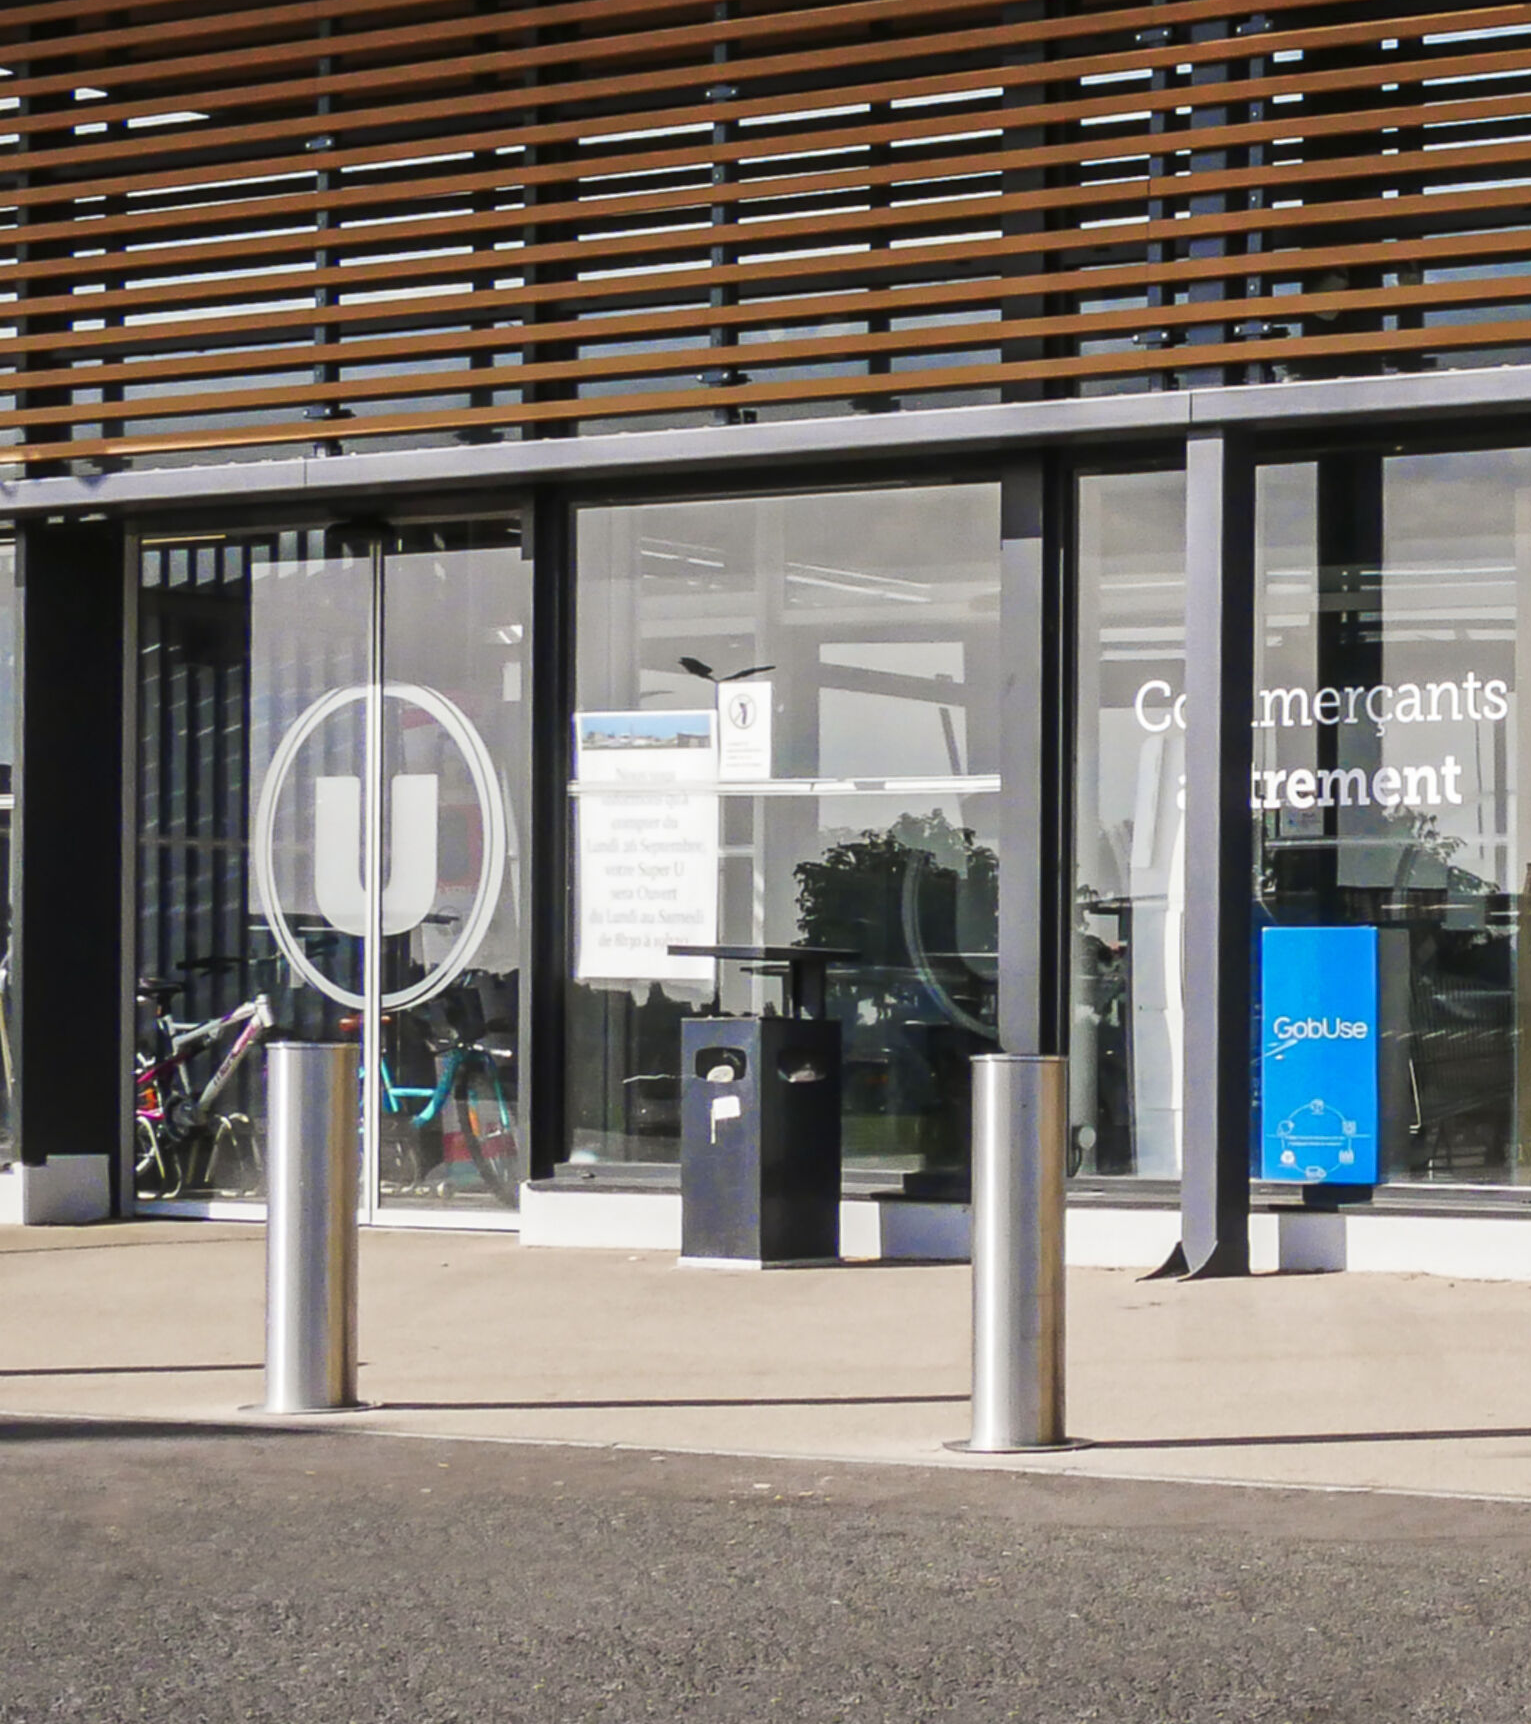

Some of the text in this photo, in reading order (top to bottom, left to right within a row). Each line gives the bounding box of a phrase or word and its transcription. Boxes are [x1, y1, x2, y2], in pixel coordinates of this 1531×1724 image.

[1135, 672, 1508, 736] Cmerçants
[1176, 756, 1462, 810] trement
[315, 774, 438, 937] U
[1273, 1016, 1369, 1039] GobUse
